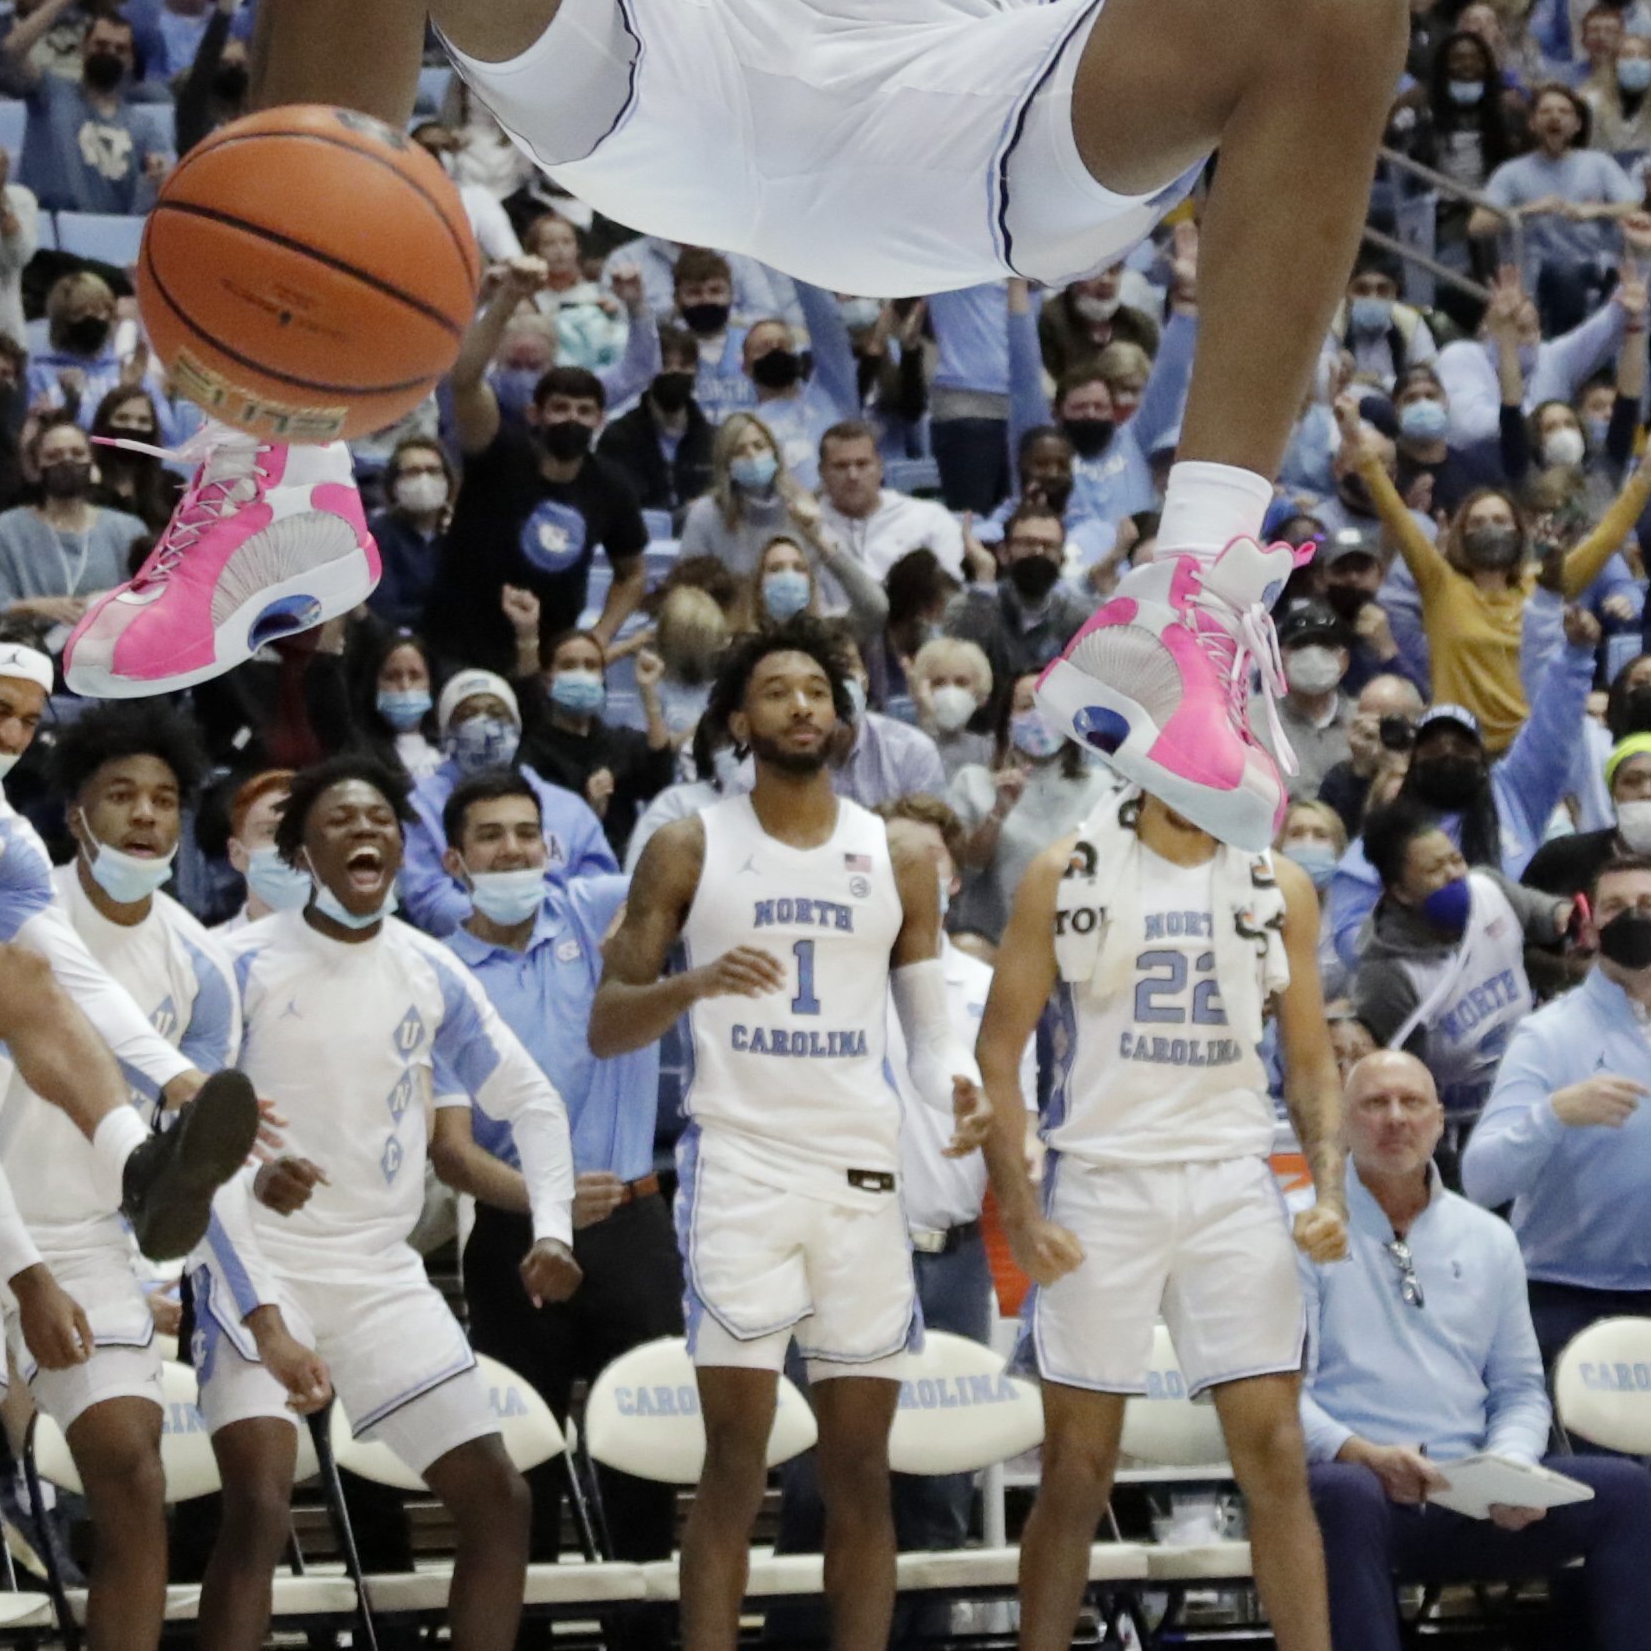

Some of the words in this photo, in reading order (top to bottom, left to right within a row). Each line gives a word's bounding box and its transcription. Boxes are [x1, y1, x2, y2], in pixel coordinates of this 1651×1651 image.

[753, 897, 854, 934] NORTH
[1144, 910, 1214, 942] NORT
[790, 938, 822, 1016] 1
[1134, 949, 1229, 1026] 22
[730, 1022, 870, 1059] CAROLINA
[1118, 1031, 1244, 1067] CAROLINA
[614, 1386, 699, 1416] CARO
[900, 1373, 1019, 1410] ROLINA
